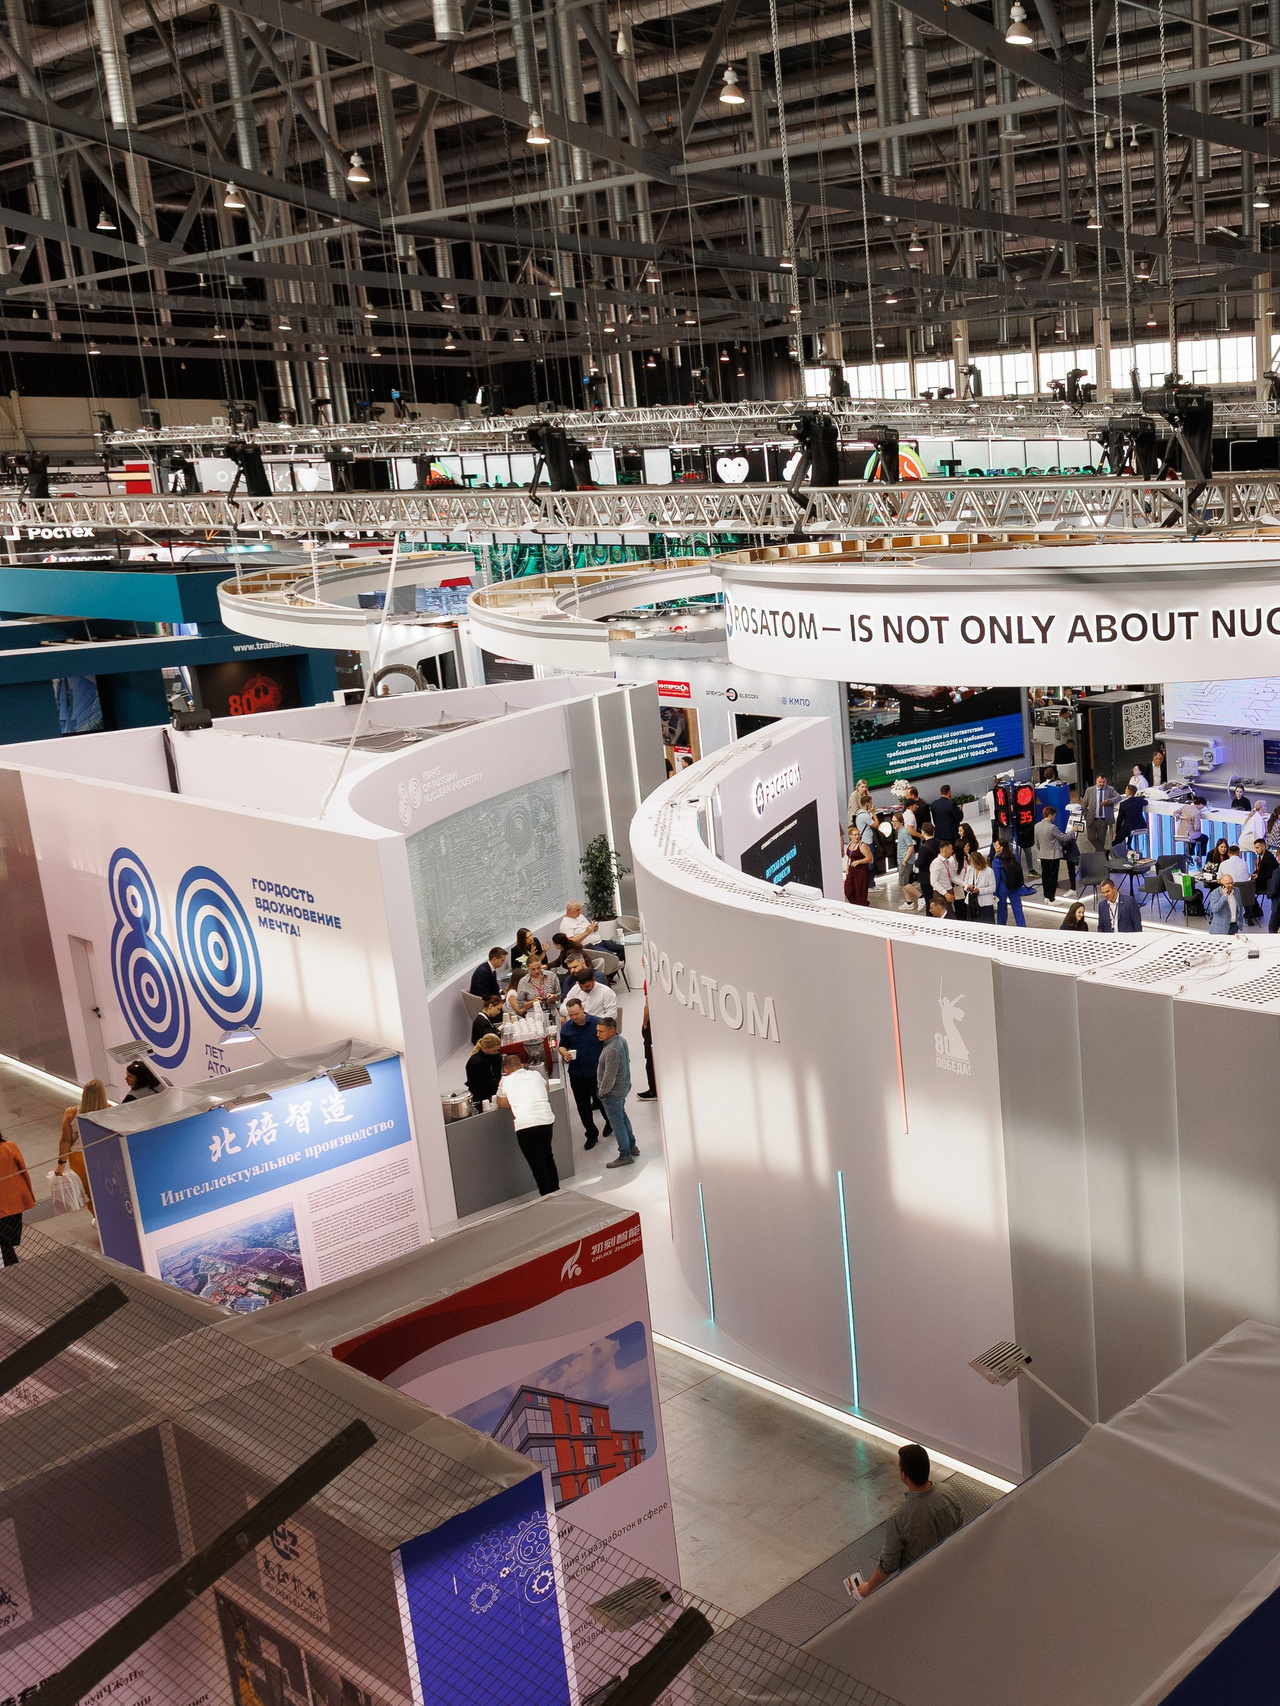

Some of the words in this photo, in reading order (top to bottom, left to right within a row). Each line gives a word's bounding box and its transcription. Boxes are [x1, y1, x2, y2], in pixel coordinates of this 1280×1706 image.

[734, 604, 818, 640] ROSATOM
[850, 614, 874, 643] IS
[883, 615, 950, 644] NOT
[960, 615, 1056, 644] ONLY
[1067, 611, 1200, 644] ABOUT
[789, 698, 810, 706] КМПО
[1020, 810, 1033, 824] 35
[251, 877, 315, 904] ГОРДОСТЬ
[255, 896, 342, 930] ВДОХНОВЕНИЕ
[258, 915, 301, 938] МЕЧТА!
[650, 941, 781, 1043] РОСАТОМ
[205, 1044, 224, 1061] ЛЕТ
[207, 1060, 232, 1075] АТО
[935, 1057, 972, 1076] ПОБЕДА!
[208, 1090, 355, 1163] 北碚智造
[159, 1151, 302, 1207] Интеллектуальное
[304, 1118, 396, 1160] производство
[591, 1250, 613, 1263] CHUKE
[614, 1236, 642, 1253] ZHINENG
[588, 1521, 637, 1557] разработок
[643, 1501, 668, 1521] сфере
